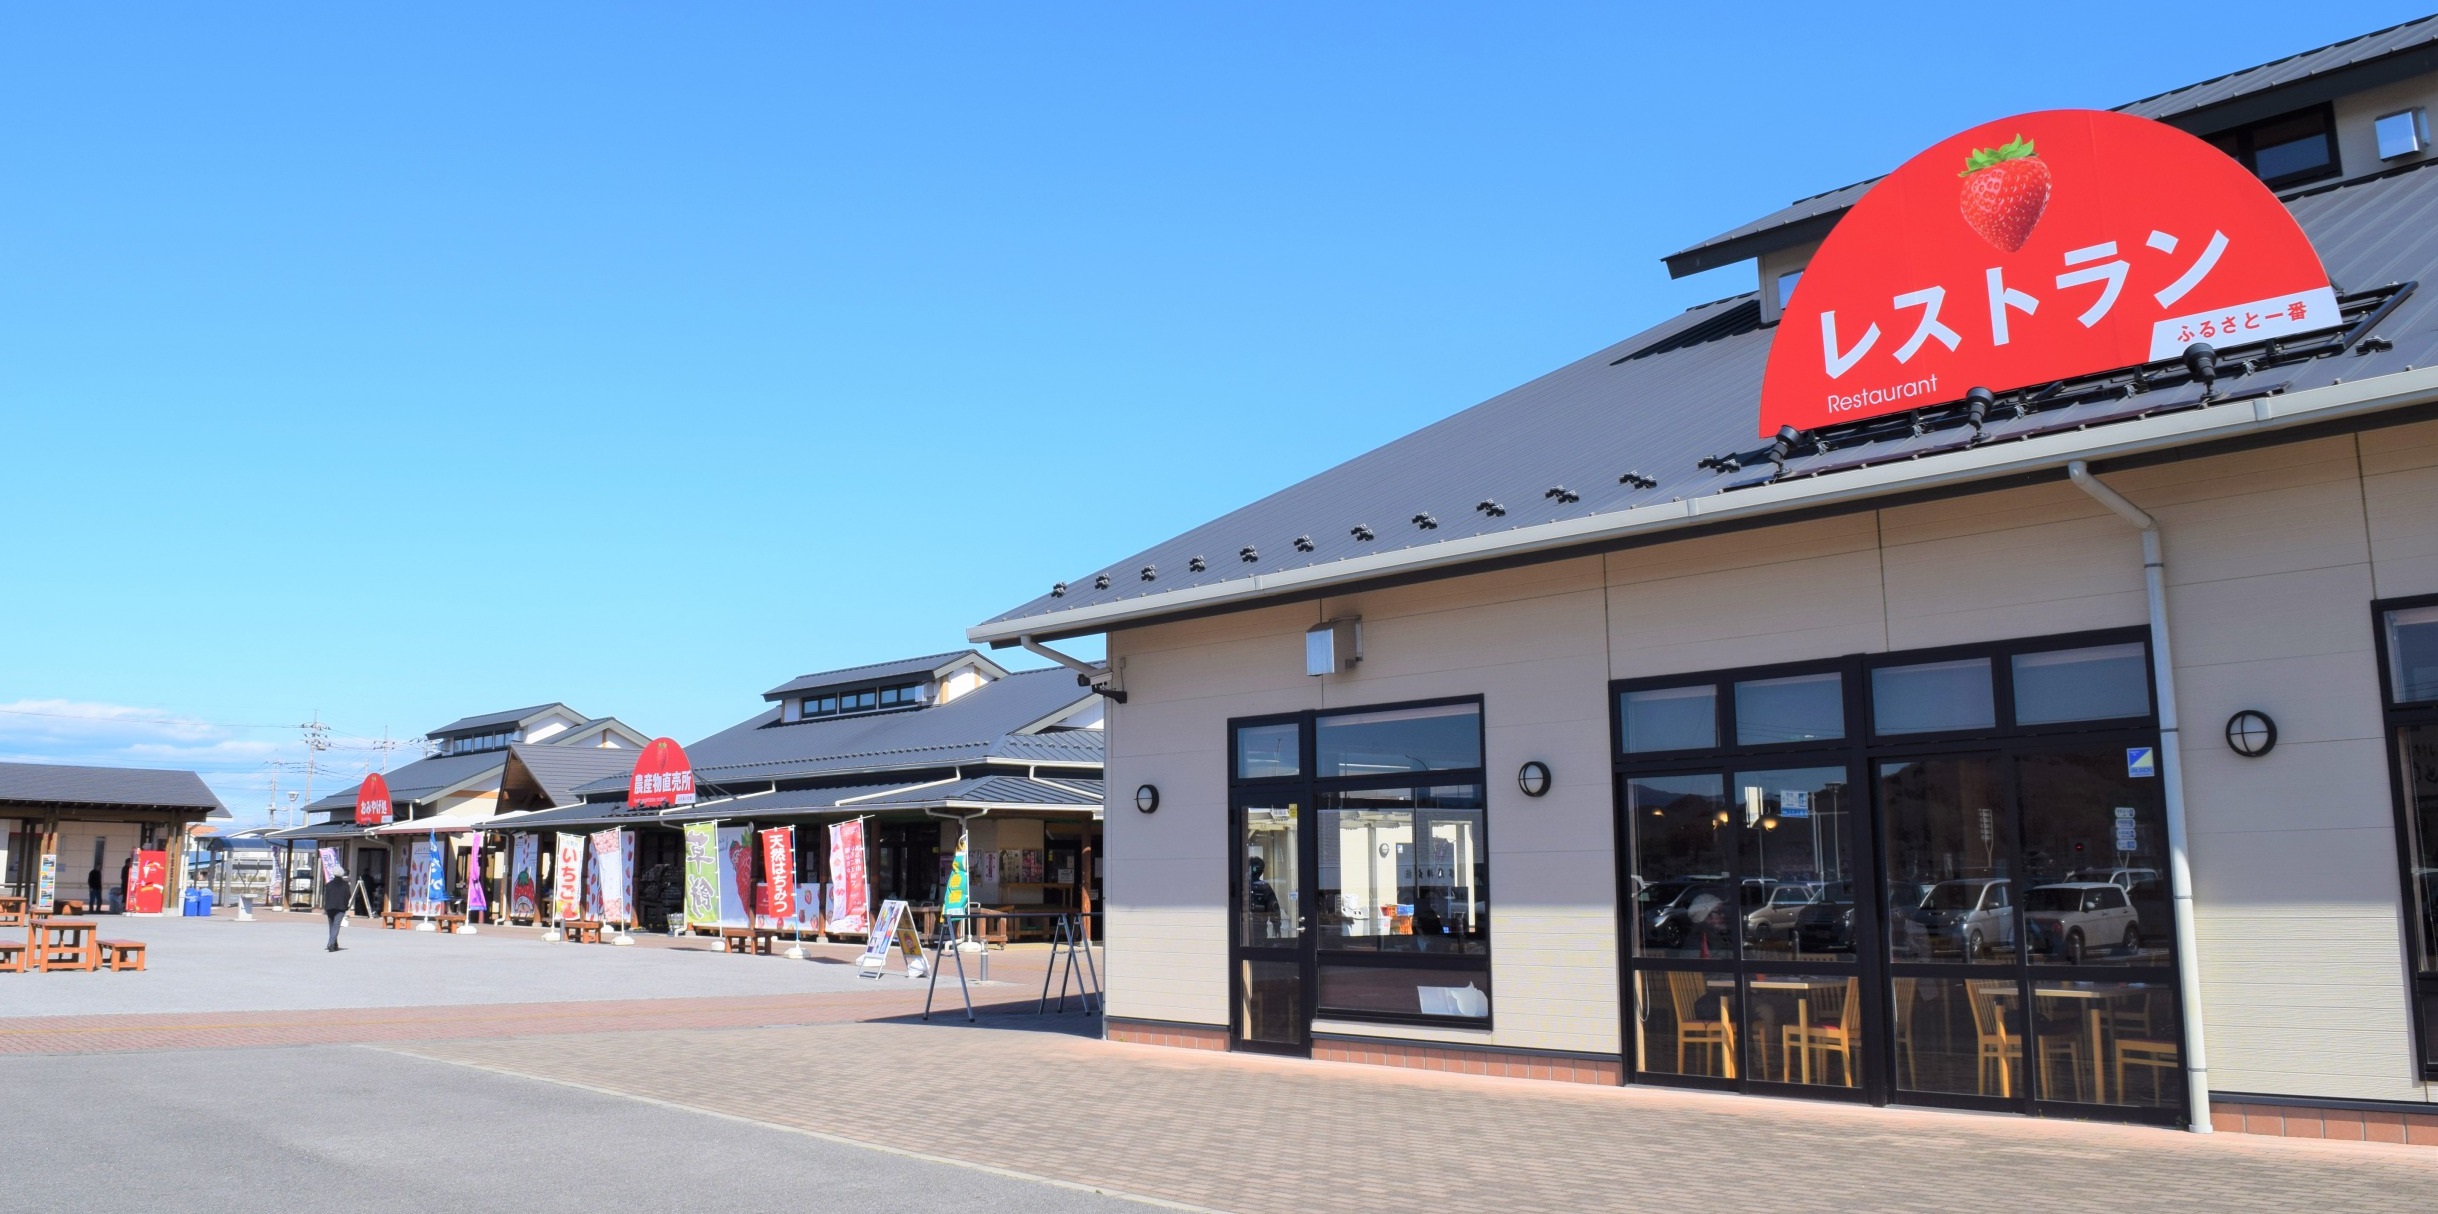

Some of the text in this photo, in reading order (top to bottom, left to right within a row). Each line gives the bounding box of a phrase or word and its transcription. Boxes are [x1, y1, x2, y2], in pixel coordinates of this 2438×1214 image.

[1820, 229, 2230, 380] レストラン
[2177, 301, 2307, 342] ふるさと一番
[1827, 373, 1938, 414] Restaurant
[634, 770, 692, 794] 農産物直売所
[360, 800, 387, 815] おみやげ処
[559, 847, 578, 901] いちご
[769, 834, 788, 913] 天然はちみつ
